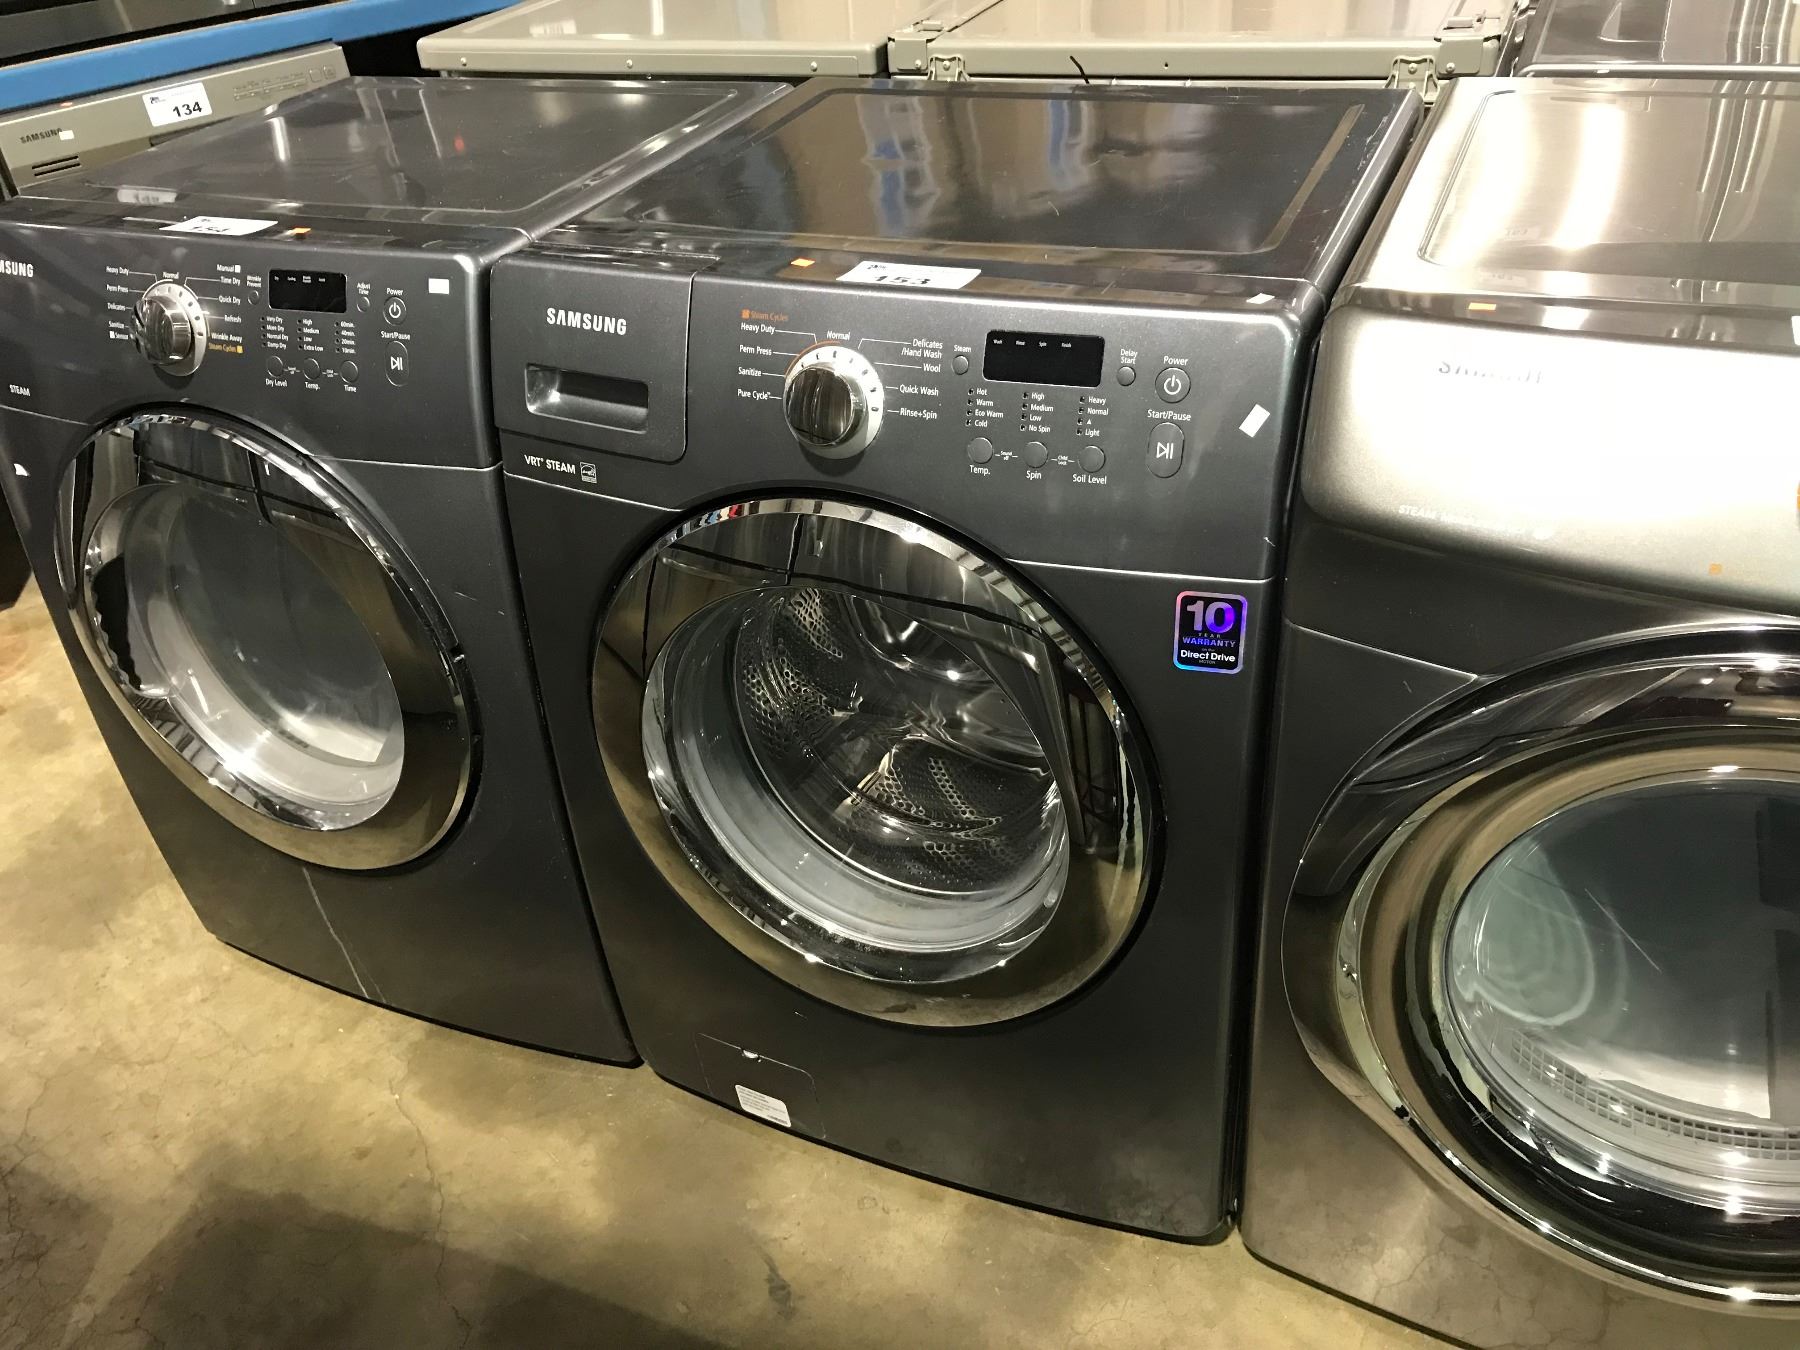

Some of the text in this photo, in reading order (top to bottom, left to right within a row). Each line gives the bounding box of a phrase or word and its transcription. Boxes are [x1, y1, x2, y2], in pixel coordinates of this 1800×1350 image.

[172, 101, 202, 118] 134
[106, 266, 129, 276] Heavy Duty
[216, 264, 234, 272] Manual
[220, 276, 240, 286] Time Dry
[106, 284, 128, 293] Perm Press
[358, 288, 369, 296] Time
[386, 288, 404, 296] Power
[218, 296, 240, 305] Quick Dry
[224, 315, 241, 323] Refresh
[546, 307, 627, 336] SAMSUNG
[740, 322, 776, 335] Heavy Duty
[211, 332, 242, 343] Wrinkle Away
[380, 331, 411, 340] Start/Pause
[826, 330, 850, 340] Normal
[912, 338, 943, 349] Delicates
[954, 344, 972, 353] Steam
[740, 344, 772, 356] Perm Press
[901, 348, 942, 359] /Hand Wash
[1120, 348, 1138, 358] Delay
[1121, 356, 1136, 364] Start
[1163, 355, 1189, 366] Power
[738, 367, 762, 377] Sanitize
[923, 363, 941, 373] Wool
[266, 378, 274, 387] Dry
[305, 382, 320, 391] Temp.
[10, 384, 31, 396] STEAM
[344, 384, 357, 392] Time
[738, 388, 751, 398] Pure
[900, 384, 939, 396] Quick Wash
[976, 388, 988, 396] Hot
[1031, 392, 1045, 401] High
[1088, 396, 1106, 406] Heavy
[976, 398, 994, 407] Warm
[1030, 404, 1054, 412] Medium
[1087, 407, 1108, 416] Normal
[900, 407, 938, 420] Rinse+Spin
[986, 410, 1004, 418] Warm
[1029, 414, 1042, 422] Low
[1147, 409, 1192, 421] Start/Pause
[974, 420, 988, 428] Cold
[1038, 425, 1050, 434] Spin
[1085, 428, 1100, 438] Light
[546, 459, 576, 474] STEAM
[970, 464, 991, 476] Temp.
[1026, 470, 1042, 480] Spin
[1072, 473, 1108, 484] Soil Level
[1187, 600, 1235, 633] 10
[1182, 637, 1236, 647] WARRANTY
[1180, 650, 1236, 662] Direct Drive
